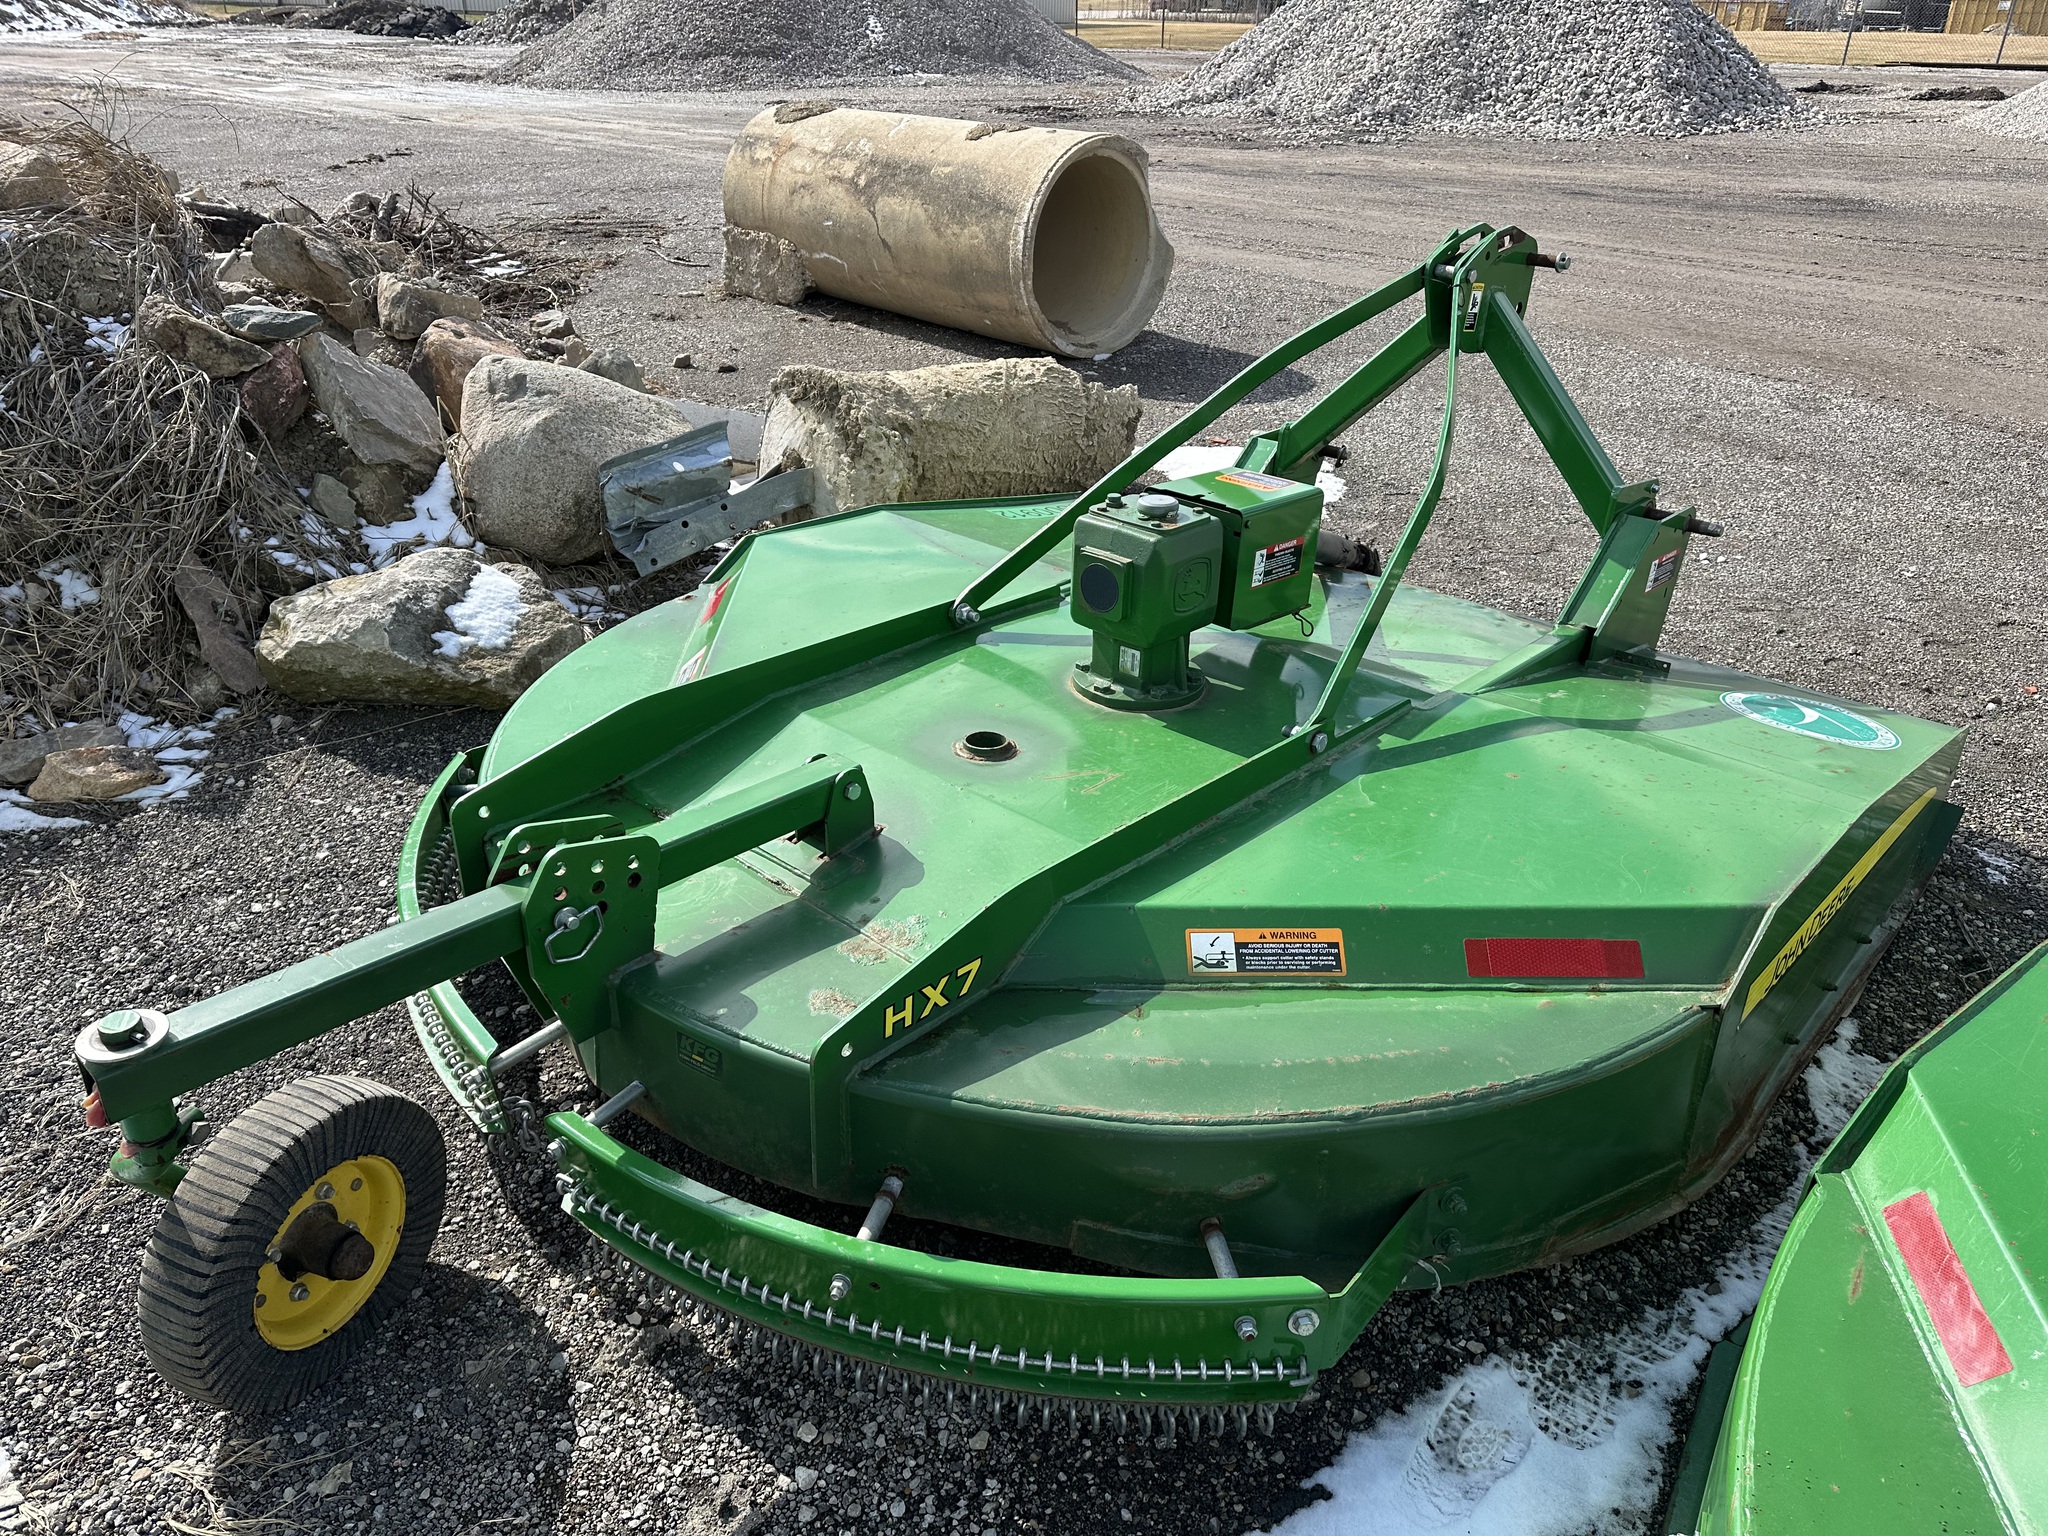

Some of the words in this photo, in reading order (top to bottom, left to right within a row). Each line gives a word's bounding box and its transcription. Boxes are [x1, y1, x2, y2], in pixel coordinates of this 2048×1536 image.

[1279, 539, 1297, 550] DANGER
[1270, 931, 1317, 940] WARNING
[1764, 927, 1810, 993] JOHN
[1807, 876, 1855, 942] DEERE
[884, 956, 982, 1039] HX7
[681, 1035, 719, 1065] KFG
